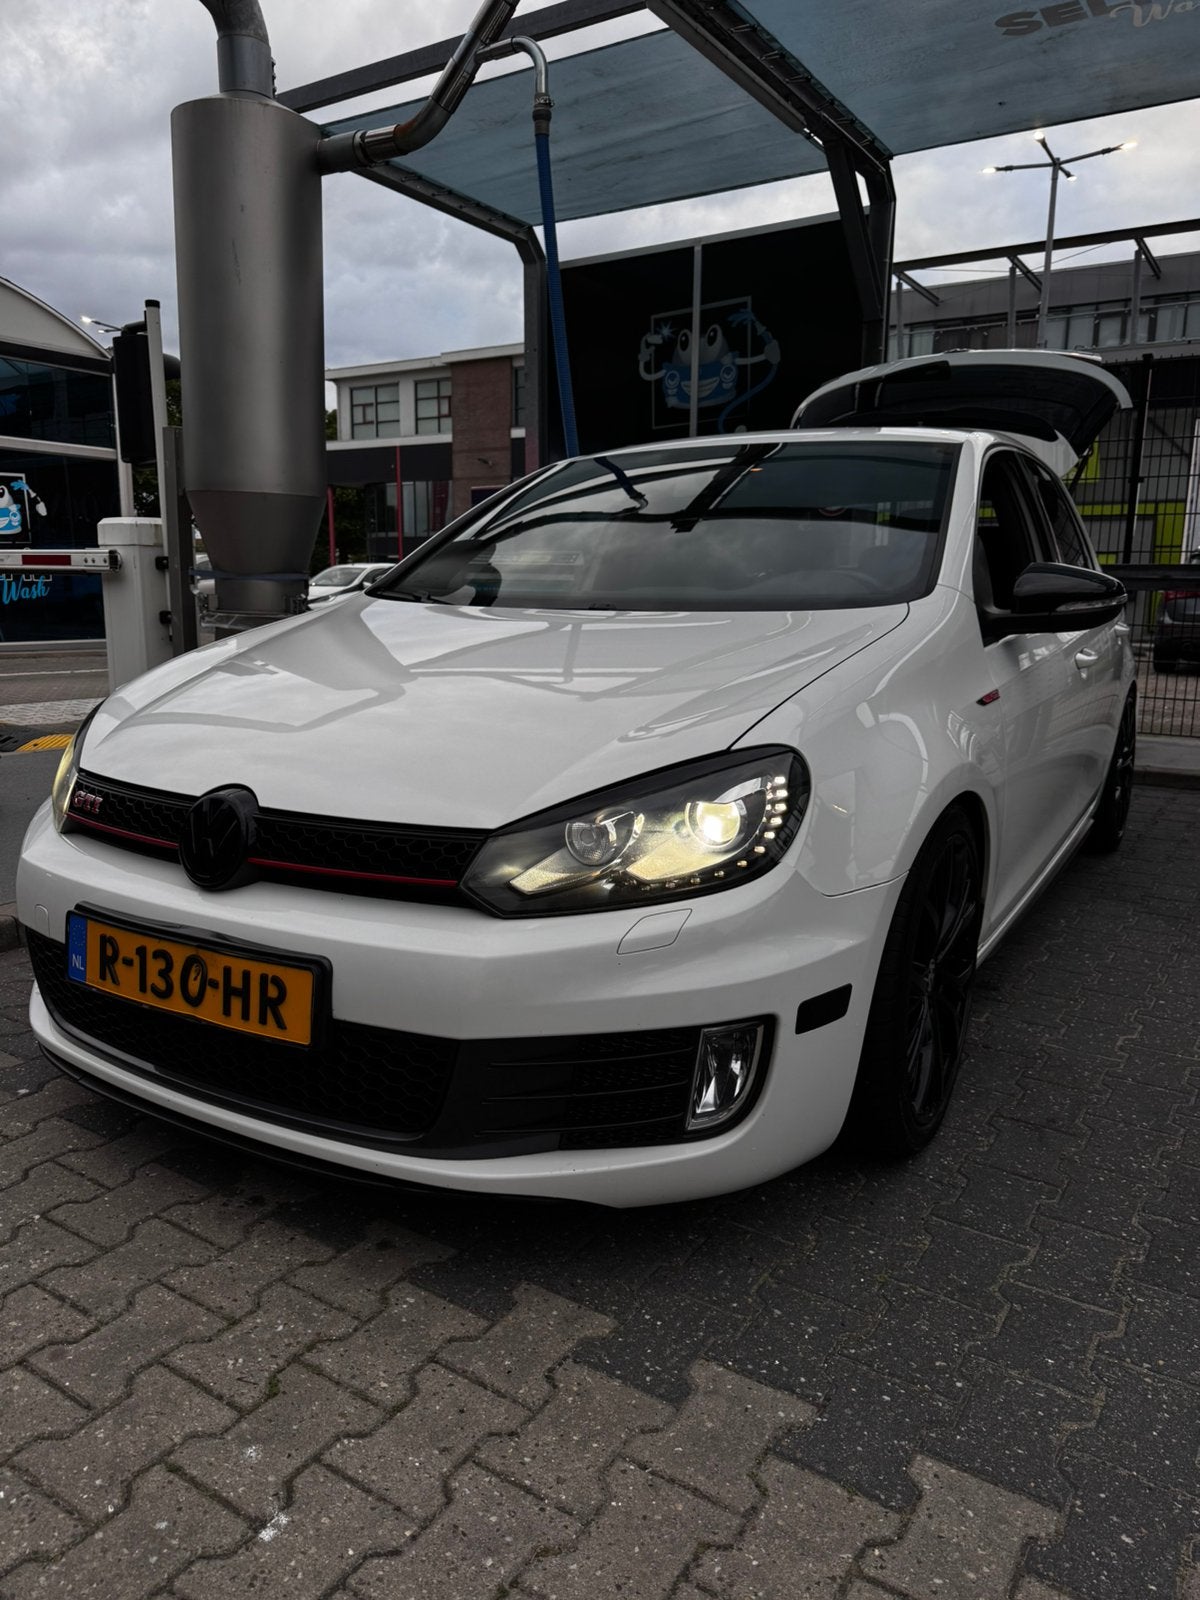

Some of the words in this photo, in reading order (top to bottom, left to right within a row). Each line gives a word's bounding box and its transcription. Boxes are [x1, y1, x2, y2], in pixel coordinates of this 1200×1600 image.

[0, 572, 51, 605] Wash
[72, 790, 103, 815] GTI
[71, 953, 85, 971] NL
[99, 933, 288, 1030] R-130-HR
